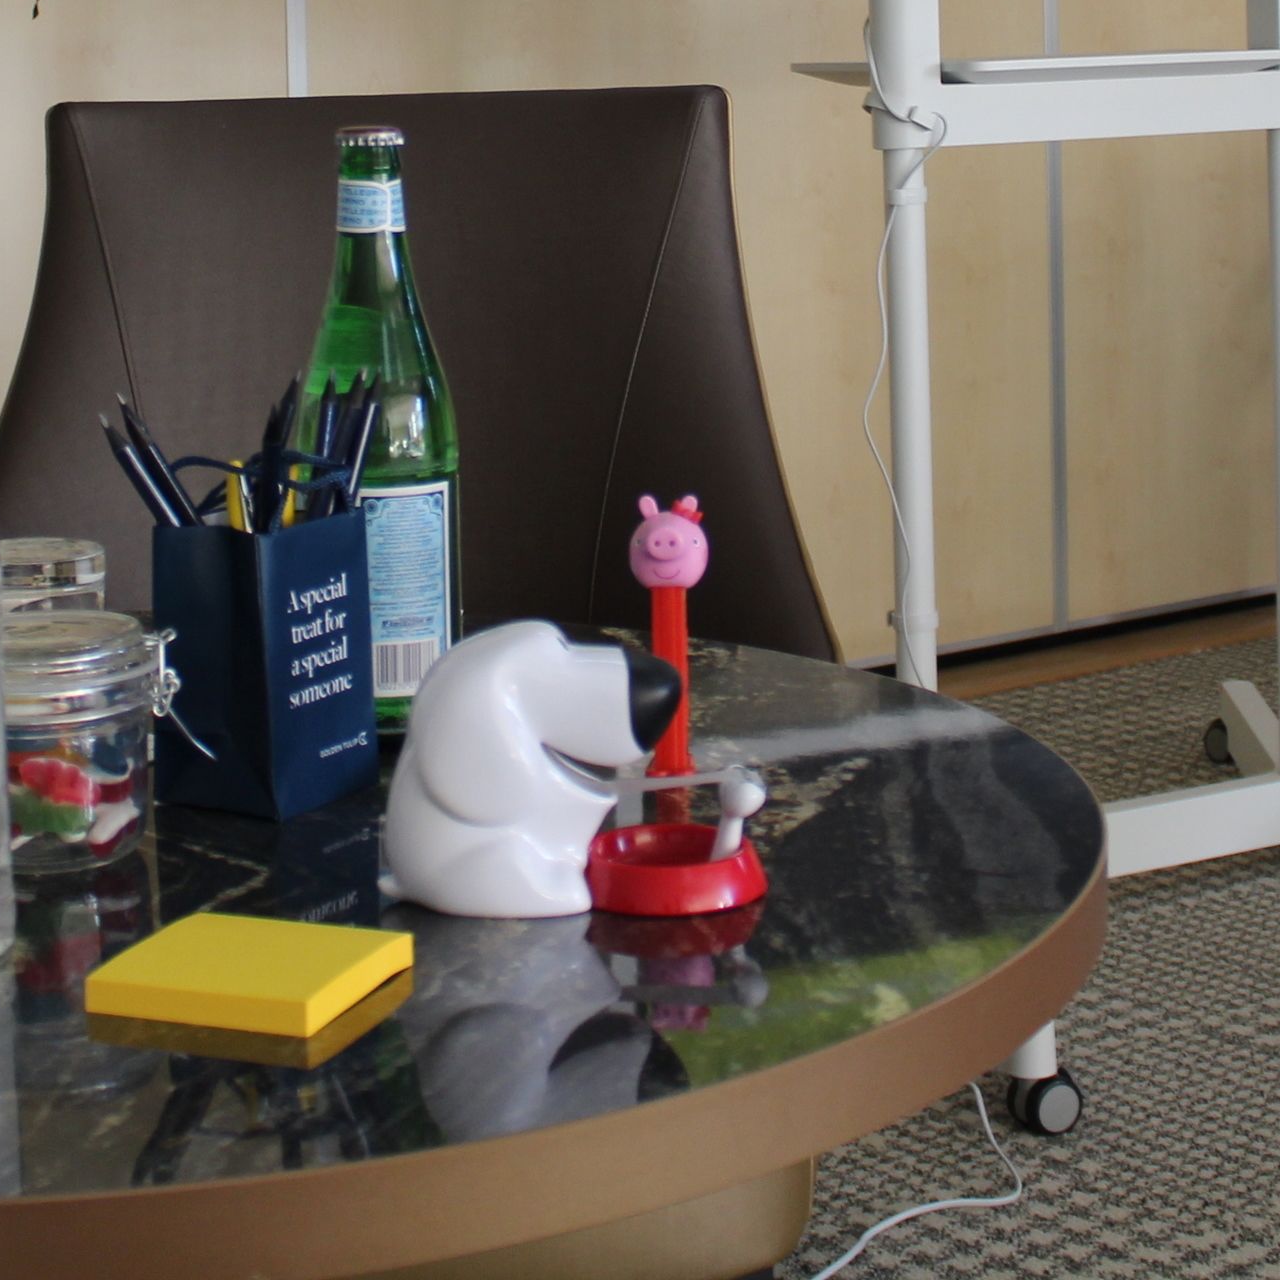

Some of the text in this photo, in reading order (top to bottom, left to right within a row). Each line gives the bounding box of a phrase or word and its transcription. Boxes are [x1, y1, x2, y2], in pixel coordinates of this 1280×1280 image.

[287, 572, 348, 614] A special
[291, 609, 347, 645] treat for
[291, 635, 348, 679] a special
[289, 673, 353, 709] someone
